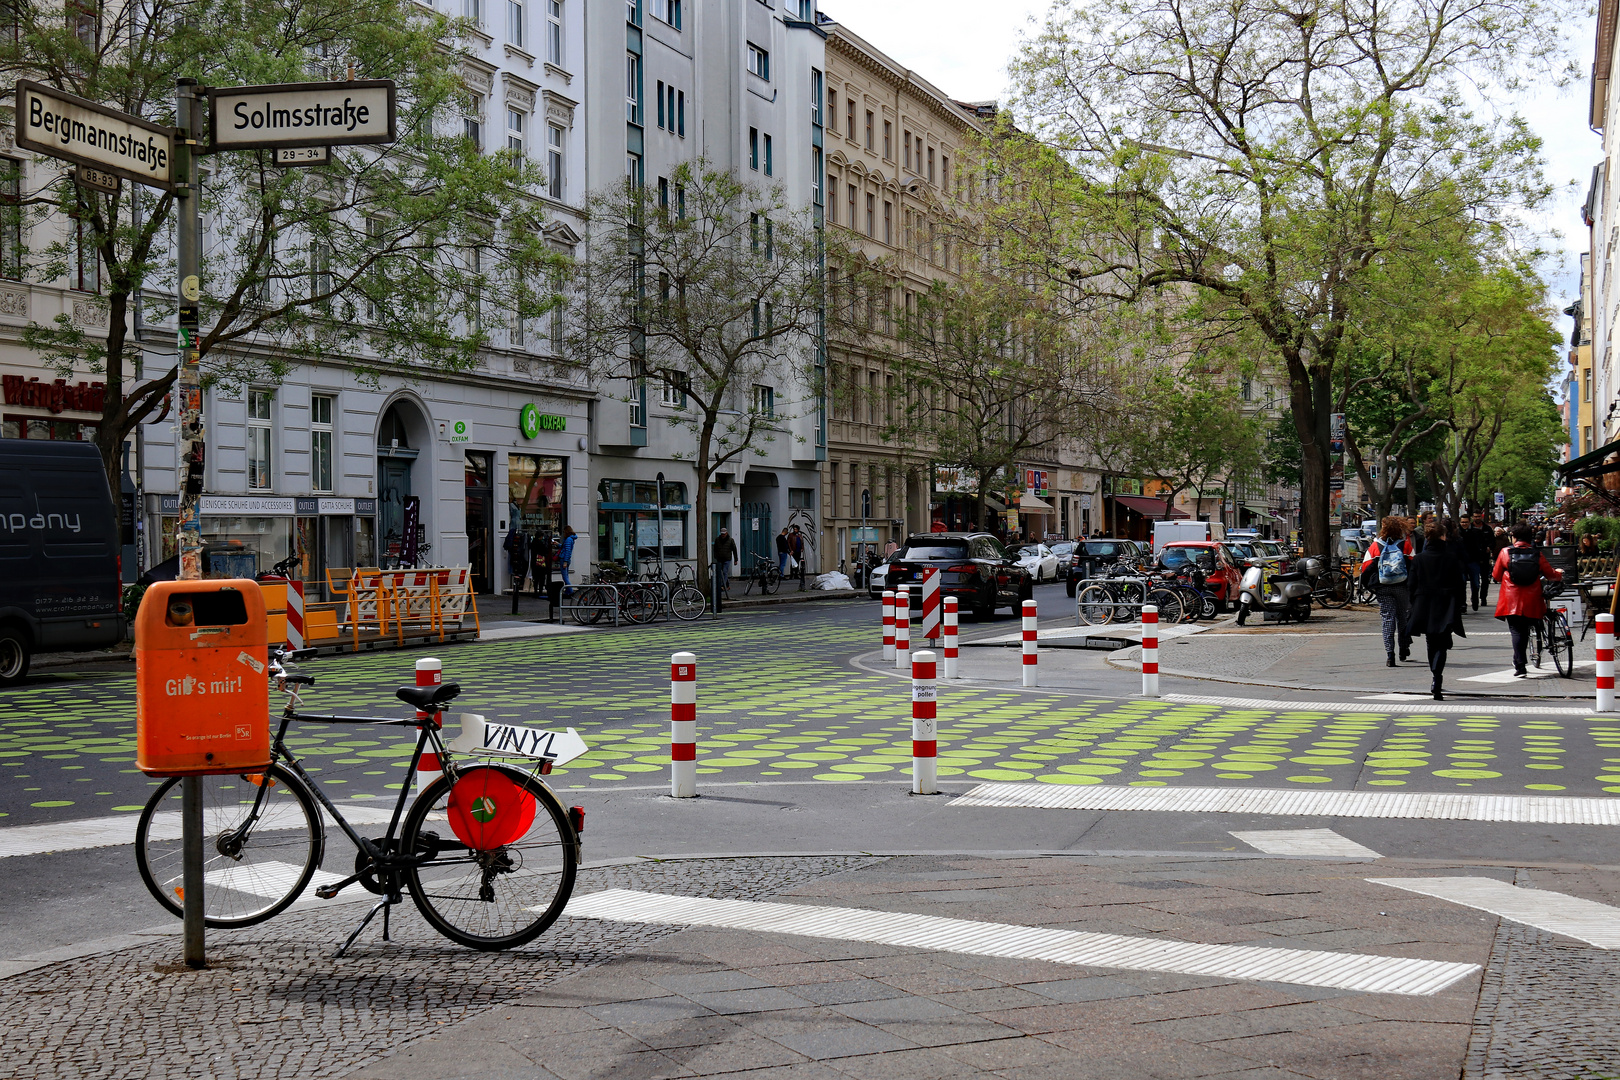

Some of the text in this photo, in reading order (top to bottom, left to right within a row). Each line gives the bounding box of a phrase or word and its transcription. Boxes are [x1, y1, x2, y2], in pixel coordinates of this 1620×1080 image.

[234, 97, 370, 131] Solmsstraße
[30, 96, 167, 171] Bergmannstraße
[282, 150, 295, 160] 29
[307, 149, 319, 158] 34
[86, 170, 113, 187] 88-93
[540, 414, 566, 431] OXFAM
[228, 500, 248, 510] SCHUHE
[249, 501, 260, 510] UND
[261, 501, 292, 510] ACCESSOIRES
[298, 501, 315, 511] OUTLET
[321, 501, 352, 510] GATTA SCHUHE
[357, 502, 373, 511] OUTLET
[210, 676, 242, 694] mir!
[236, 727, 250, 738] BSR
[484, 724, 558, 757] VINYL
